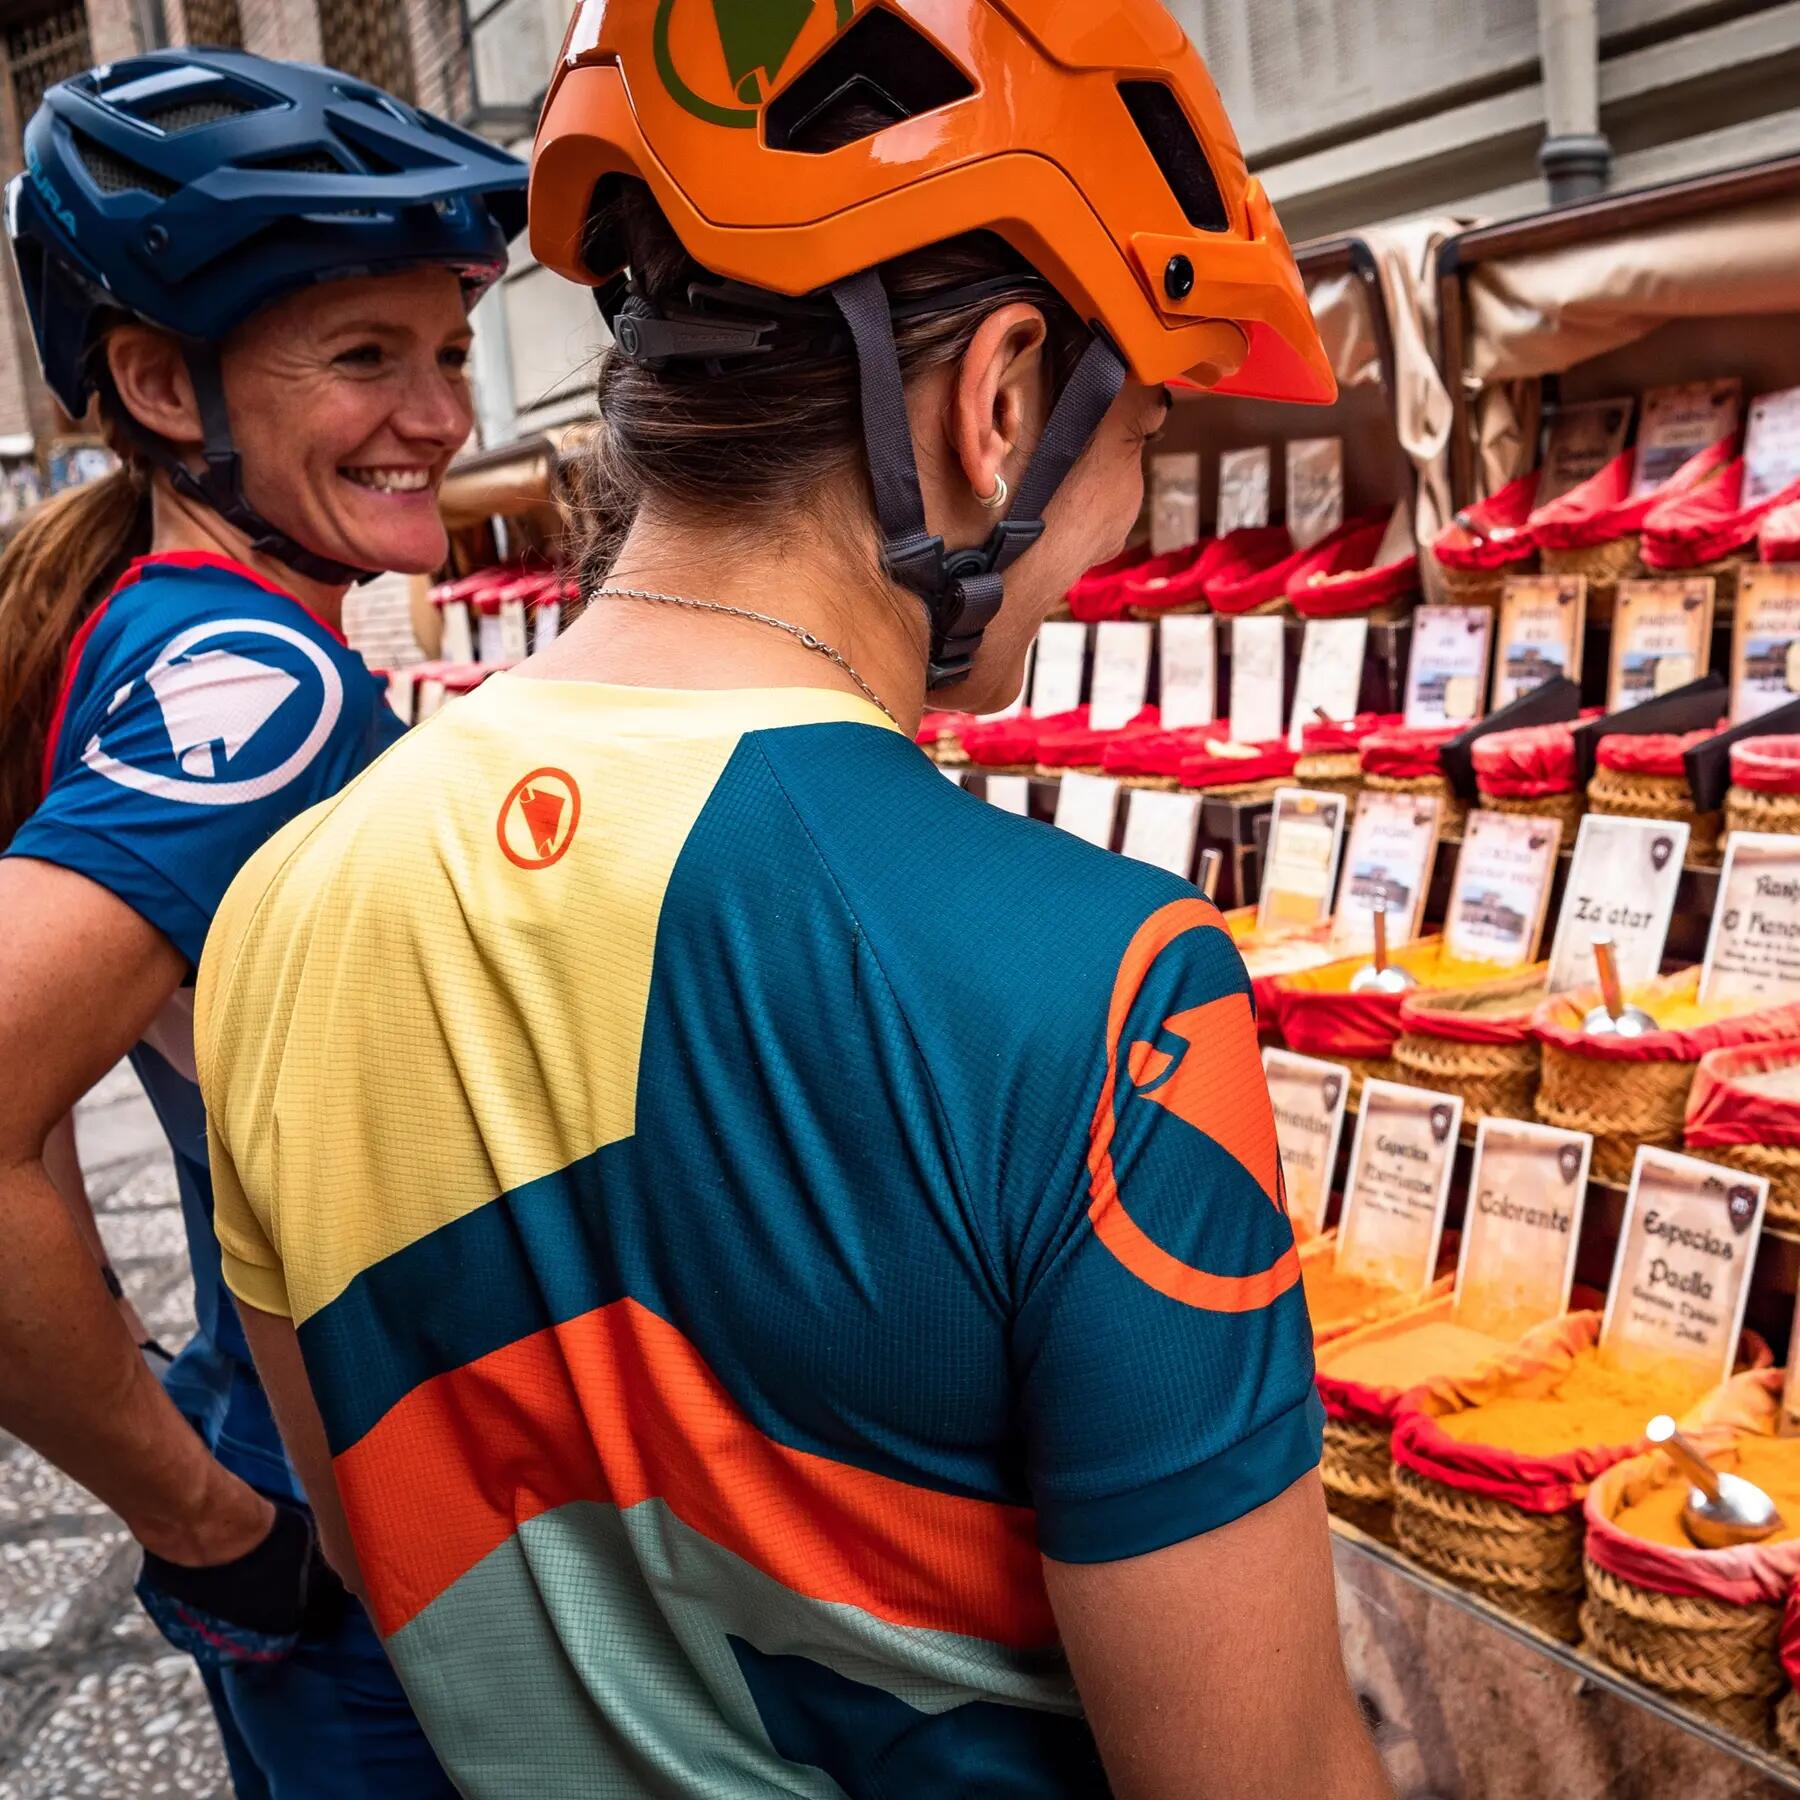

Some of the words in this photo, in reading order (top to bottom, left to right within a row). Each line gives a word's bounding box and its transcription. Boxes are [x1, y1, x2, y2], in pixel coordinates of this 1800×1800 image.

[1478, 1189, 1569, 1233] Colorante
[1643, 1210, 1734, 1261] Especias
[1649, 1258, 1714, 1300] Paella
